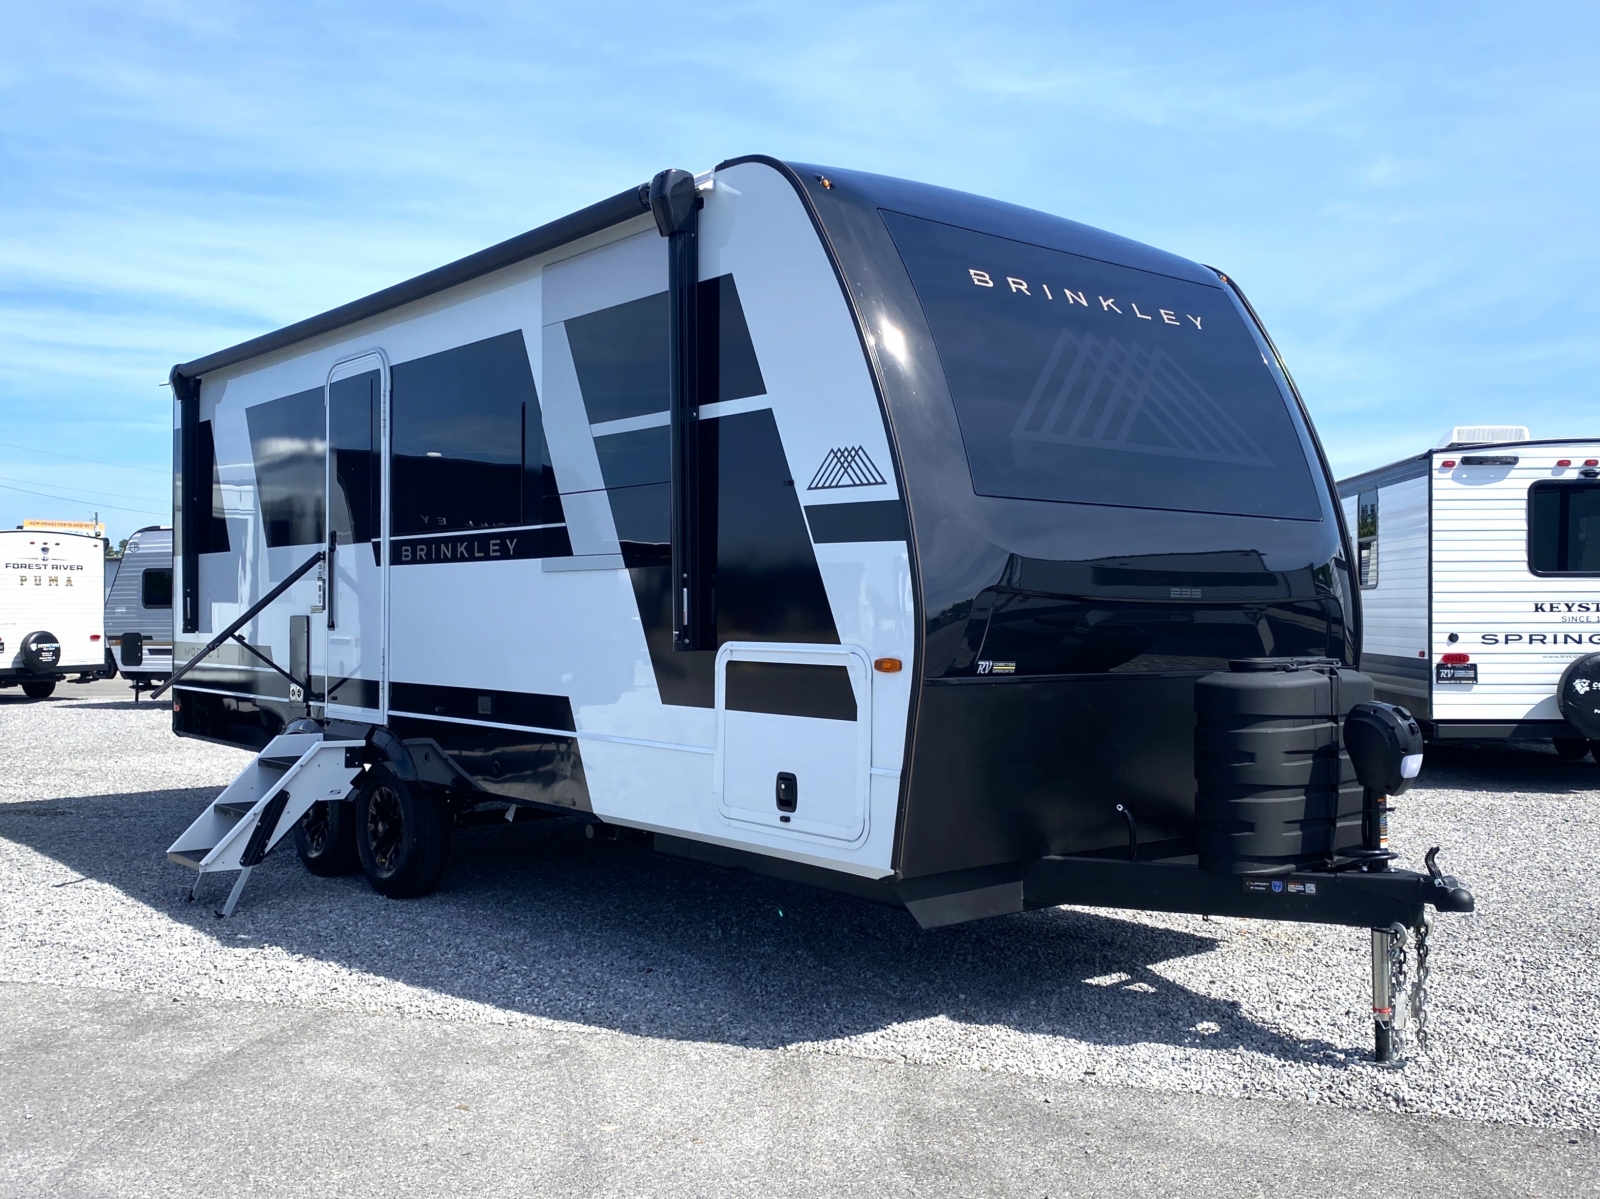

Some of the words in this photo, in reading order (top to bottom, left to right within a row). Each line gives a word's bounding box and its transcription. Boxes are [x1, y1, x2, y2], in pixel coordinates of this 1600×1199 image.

[968, 268, 1202, 330] BRINKLEY
[401, 538, 518, 562] BRINKLEY
[5, 562, 48, 570] FOREST
[19, 575, 73, 587] PUMA
[1561, 615, 1592, 623] SINCE
[1480, 633, 1600, 645] SPRING
[976, 659, 993, 674] RV
[1439, 669, 1454, 678] RV
